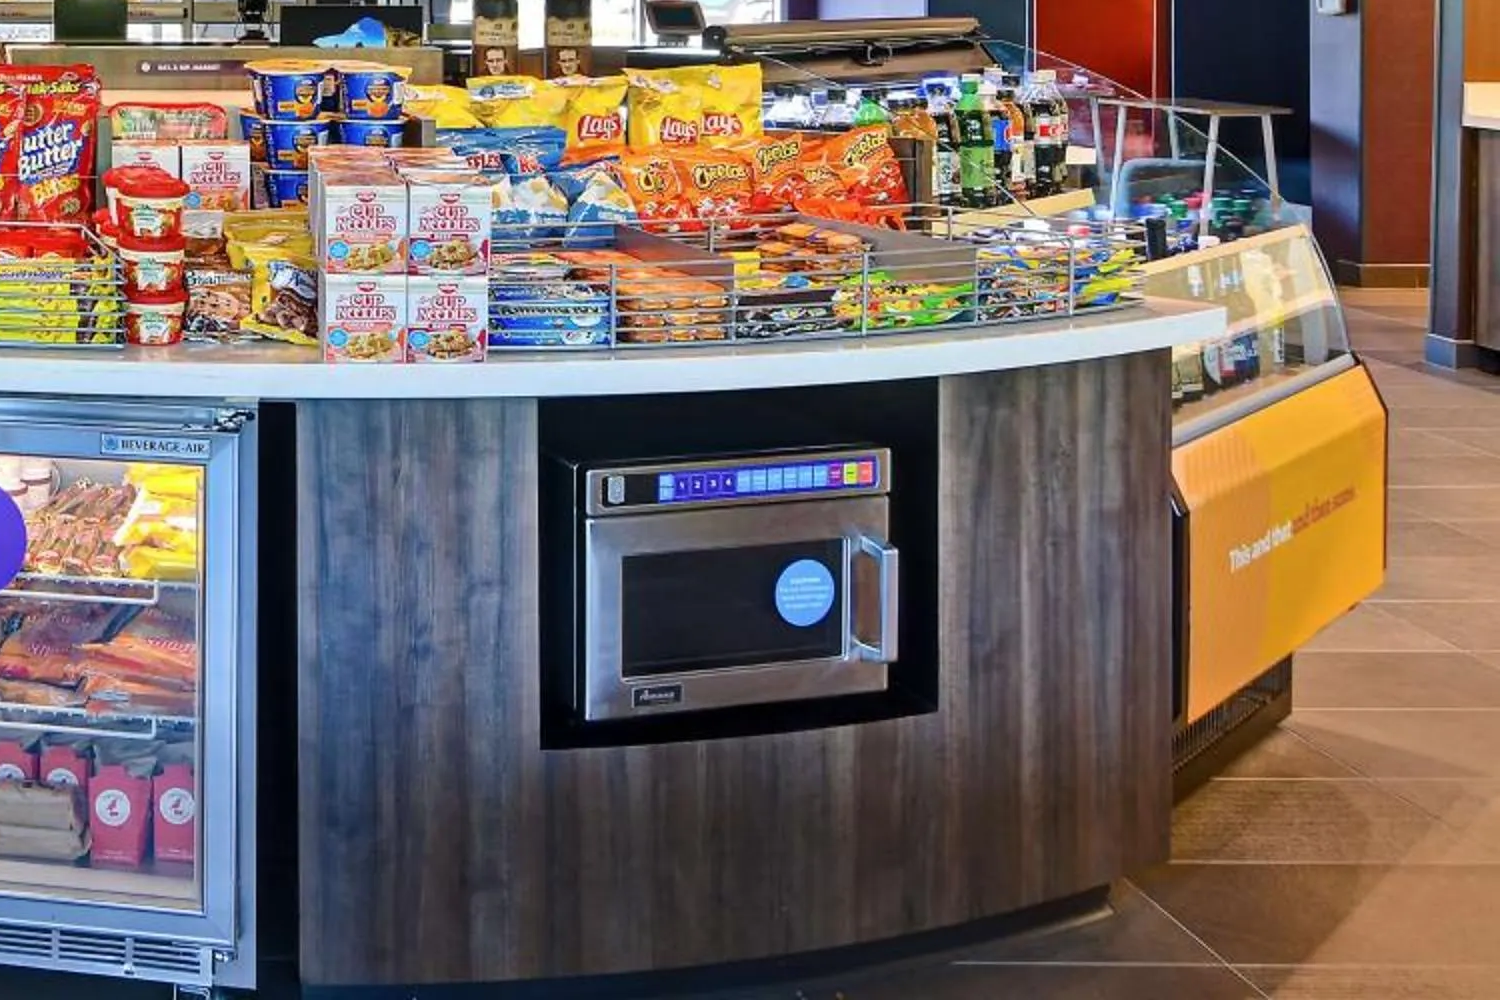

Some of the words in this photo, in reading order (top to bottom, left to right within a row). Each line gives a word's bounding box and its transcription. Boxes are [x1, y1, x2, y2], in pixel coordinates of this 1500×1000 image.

[17, 139, 84, 182] Butter
[692, 164, 748, 190] Cheetos
[349, 203, 385, 219] CUP
[435, 205, 469, 220] CUP
[335, 215, 397, 233] NOODLES
[418, 217, 481, 233] NOODLES
[349, 293, 385, 307] CUP
[432, 295, 467, 309] CUP
[335, 305, 397, 321] NOODLES
[416, 307, 478, 322] NOODLES
[120, 439, 206, 454] BEVERAGE-AIR
[1229, 543, 1252, 574] This
